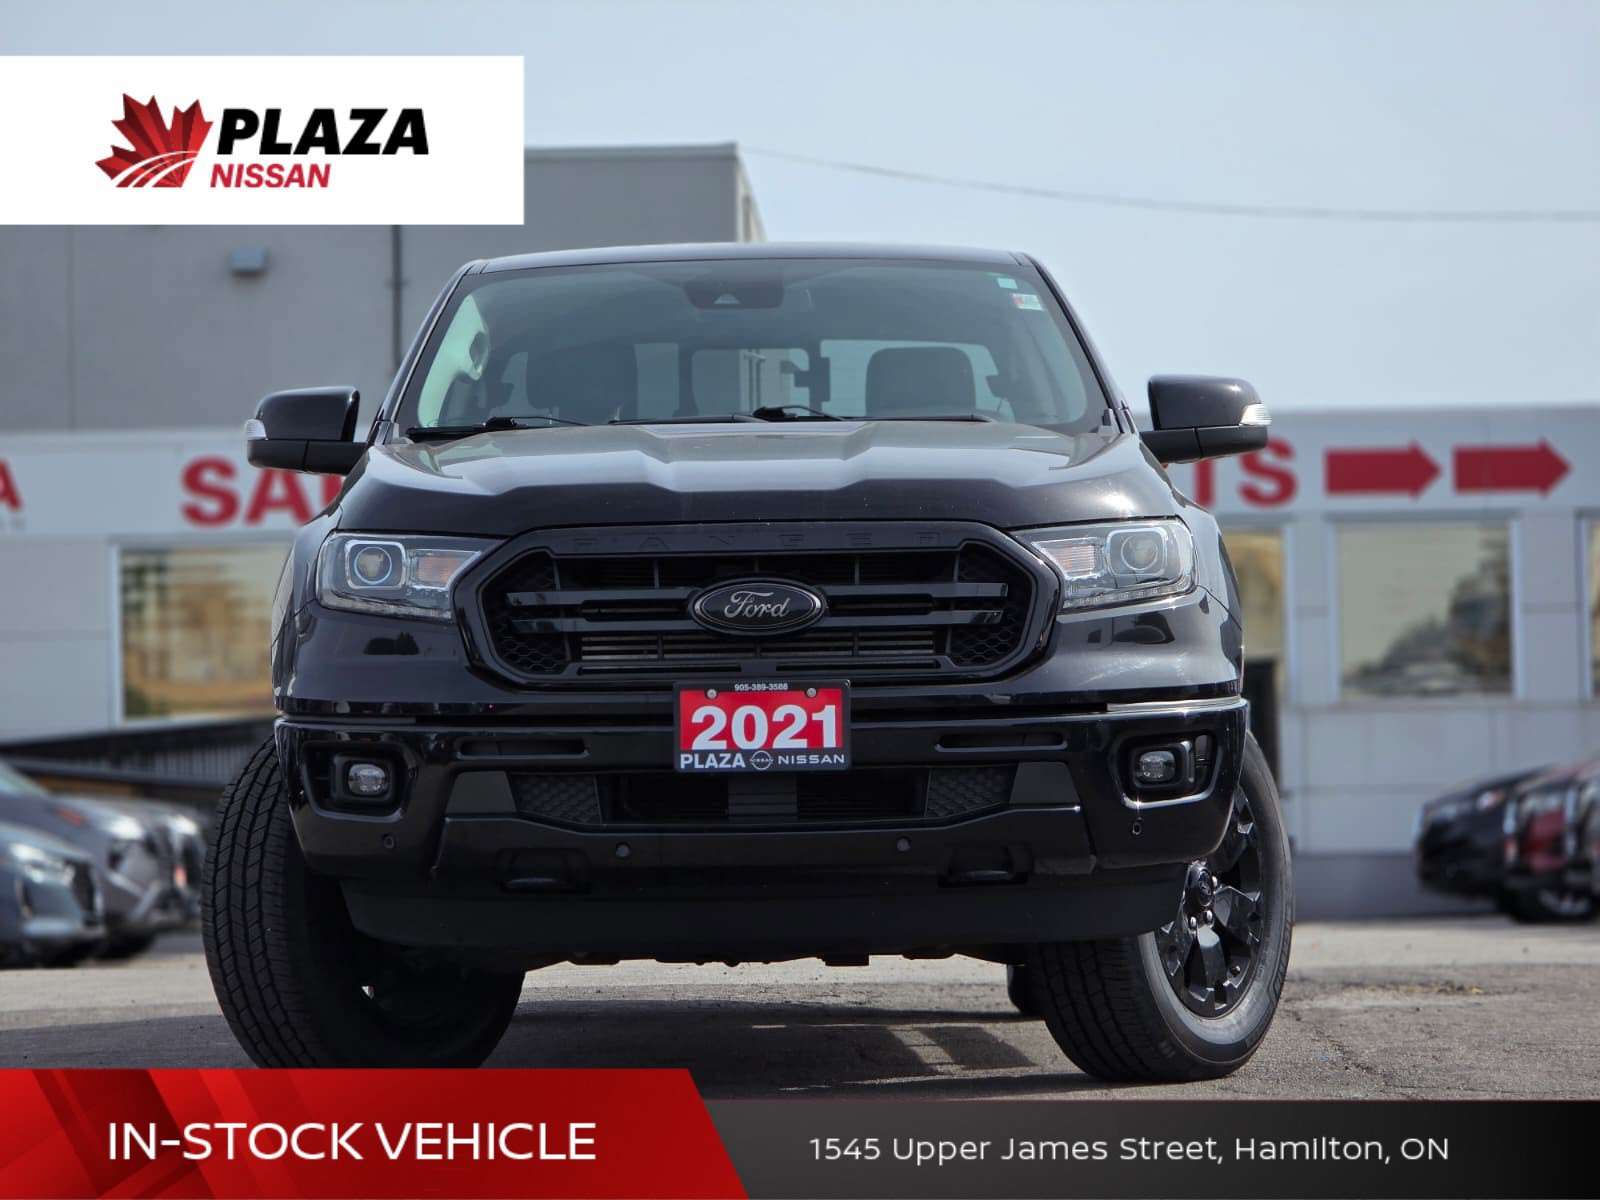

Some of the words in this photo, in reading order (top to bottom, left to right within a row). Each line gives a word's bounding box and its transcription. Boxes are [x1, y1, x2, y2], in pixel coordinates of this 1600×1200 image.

[723, 590, 791, 619] Ford
[691, 704, 837, 750] 2021
[680, 753, 746, 769] PLAZA
[778, 754, 845, 765] NISSAN
